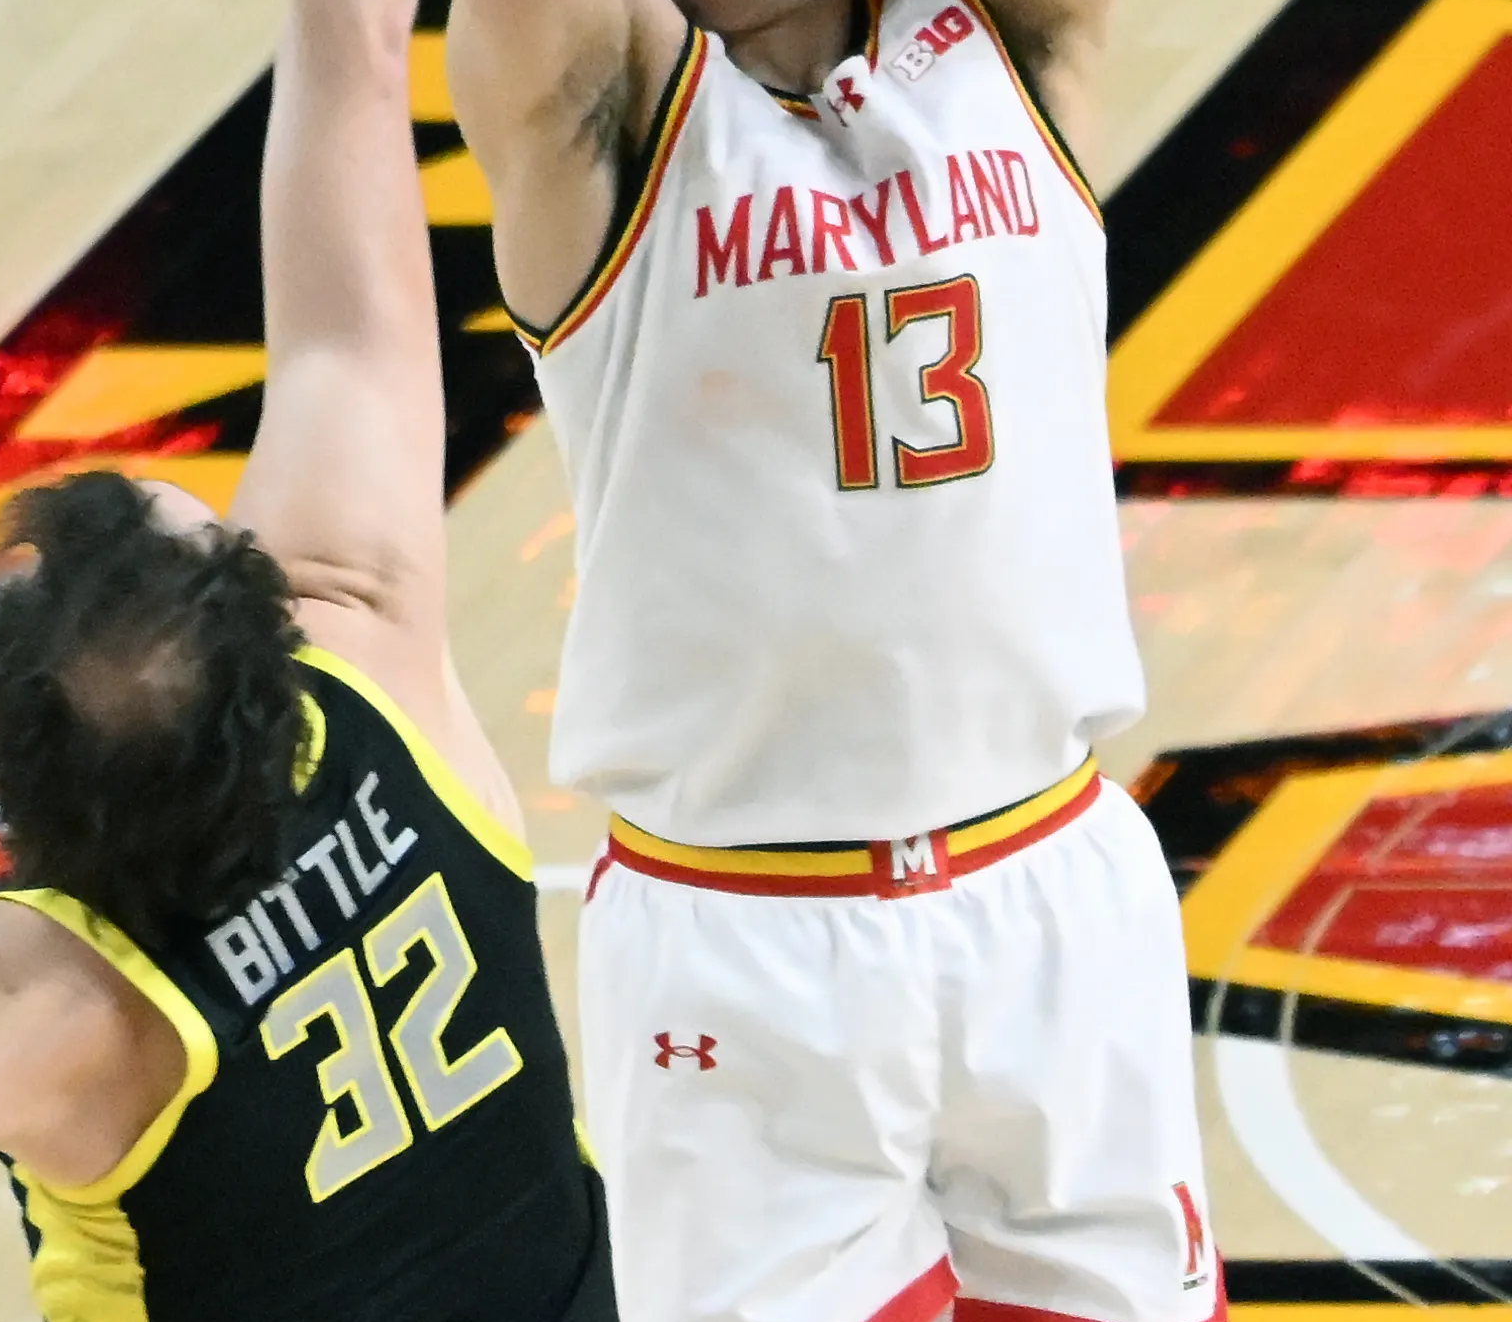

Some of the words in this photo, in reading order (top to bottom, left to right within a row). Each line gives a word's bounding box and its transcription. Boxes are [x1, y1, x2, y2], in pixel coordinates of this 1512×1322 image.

[693, 149, 1041, 300] MARYLAND
[817, 273, 996, 492] 13
[204, 770, 420, 1007] BITTLE
[891, 830, 938, 880] M
[259, 870, 525, 1204] 32
